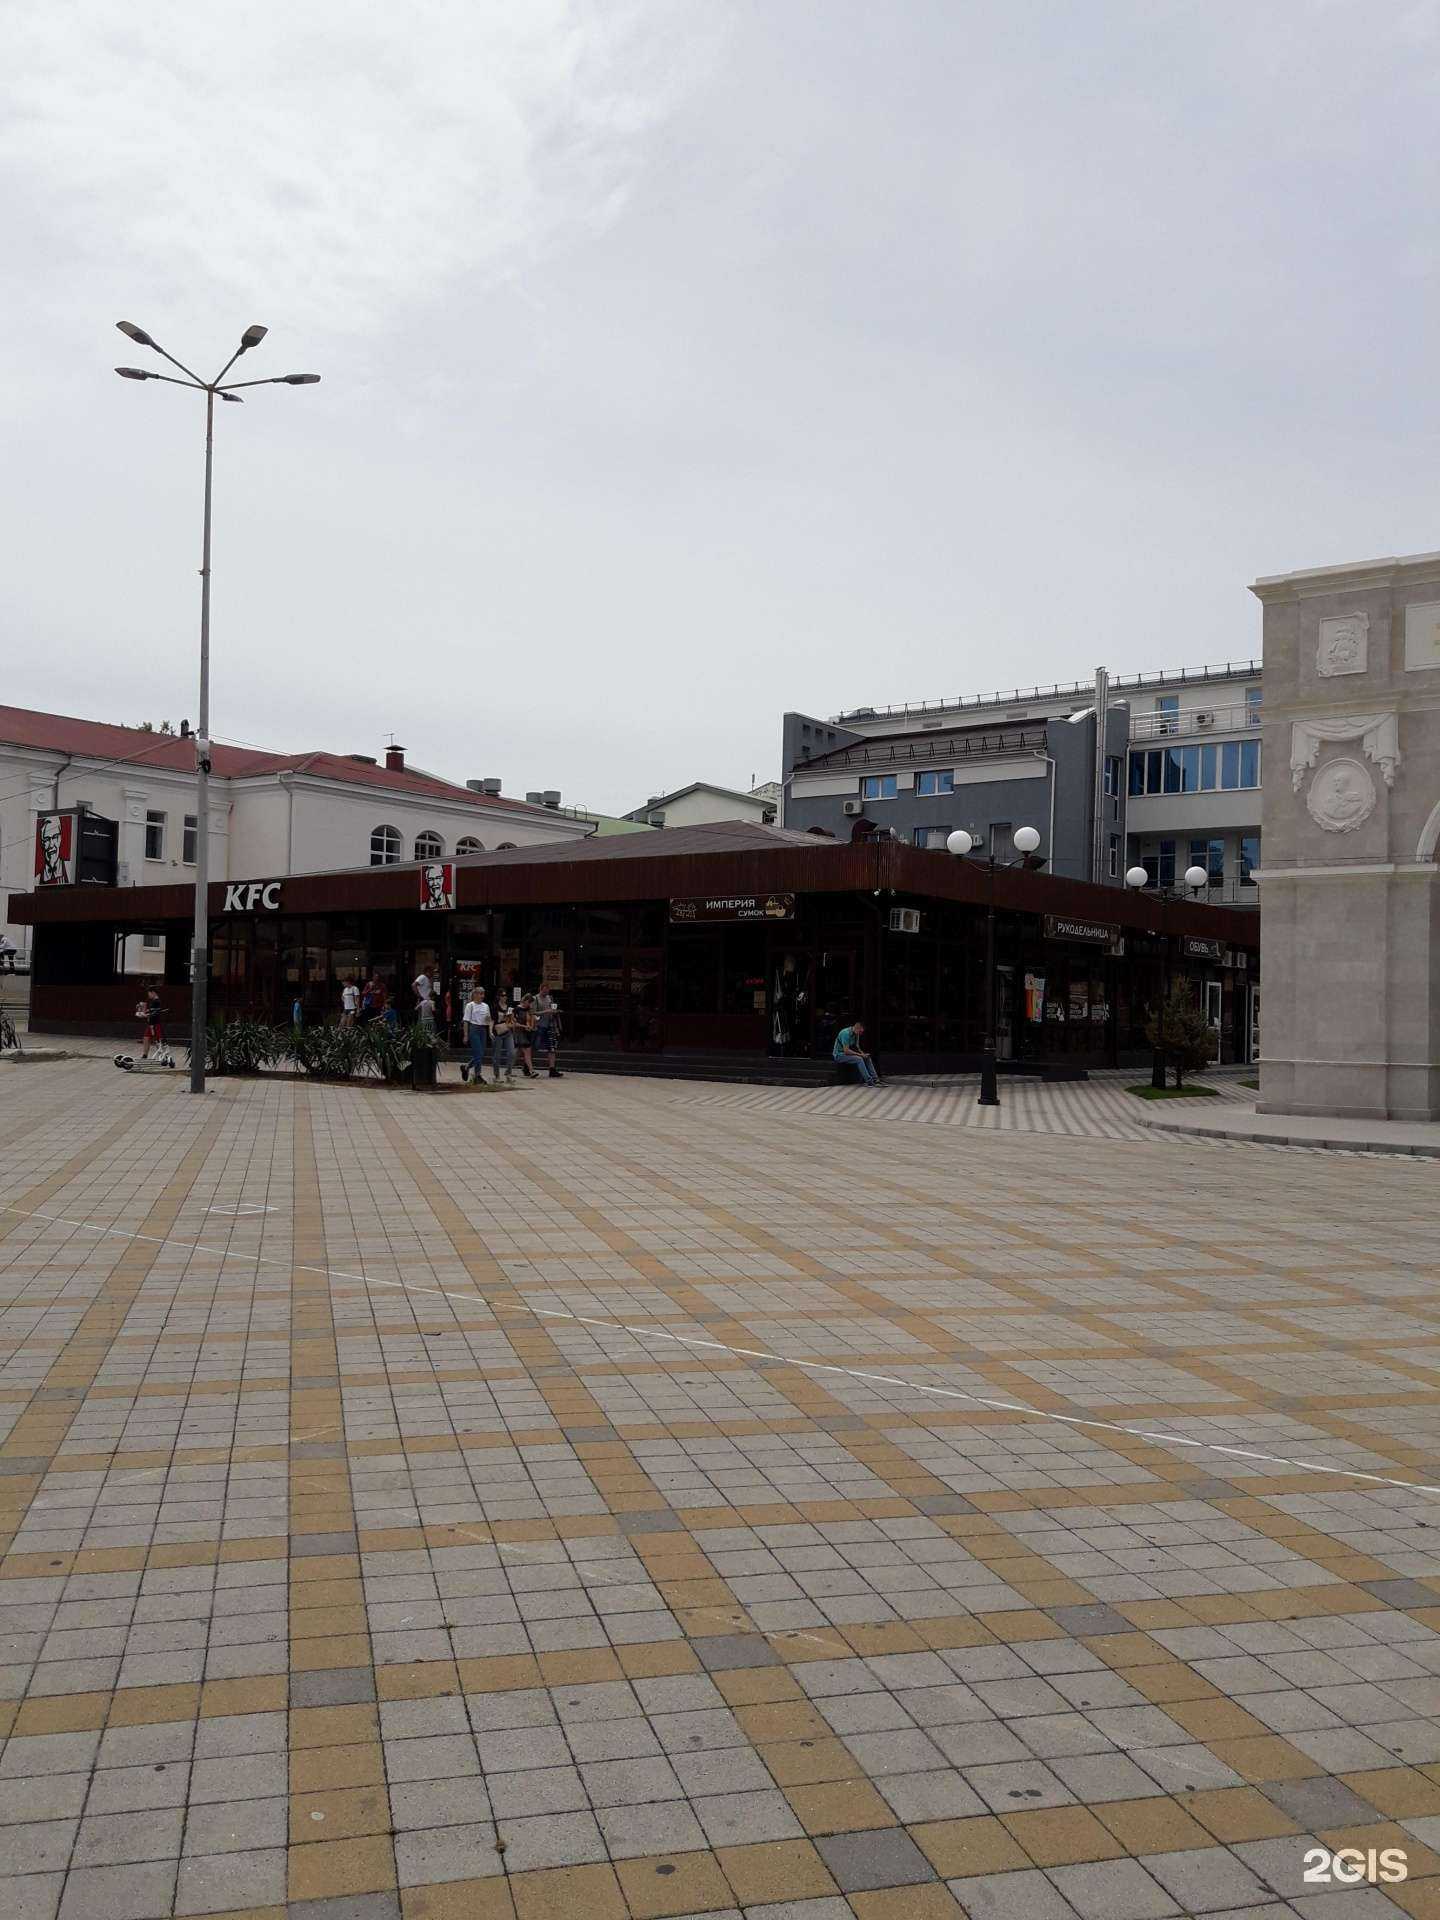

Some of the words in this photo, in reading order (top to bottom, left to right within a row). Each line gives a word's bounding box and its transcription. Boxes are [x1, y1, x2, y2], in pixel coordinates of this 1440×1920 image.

[223, 882, 281, 911] KFC
[706, 899, 756, 909] ИМПЕРИЯ
[1057, 922, 1109, 939] РУКОДЕЛЬНИЦА
